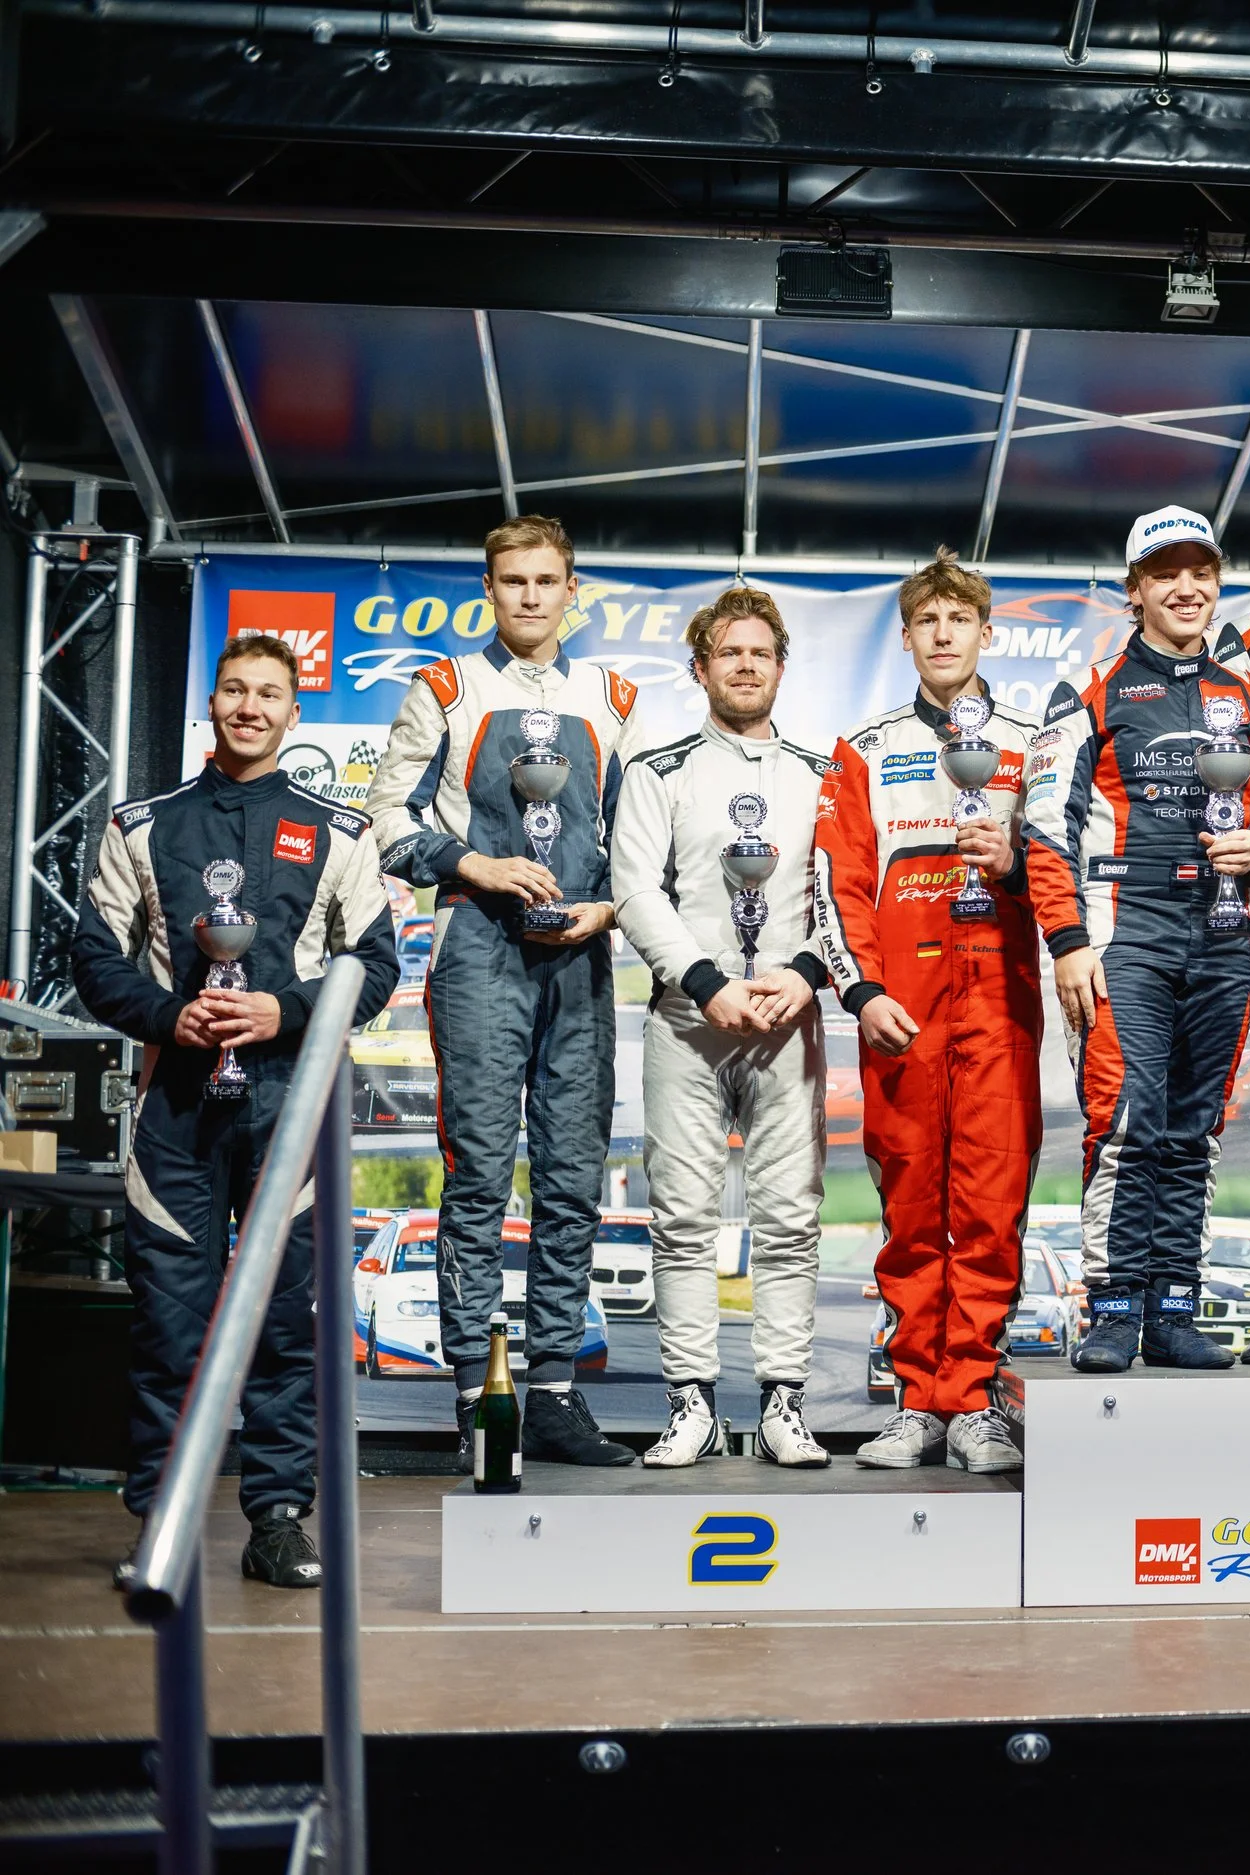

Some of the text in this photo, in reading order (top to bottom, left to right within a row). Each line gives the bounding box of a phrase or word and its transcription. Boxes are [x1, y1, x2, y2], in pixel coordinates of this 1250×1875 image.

[1143, 518, 1208, 537] GOODYEAR
[979, 626, 1082, 658] DMV
[1174, 663, 1198, 677] freem
[1119, 683, 1165, 694] HAMPL
[960, 706, 979, 714] DMV
[1212, 707, 1233, 715] DMV
[530, 719, 550, 728] DMV
[858, 733, 879, 749] OMP
[654, 756, 678, 770] OMP
[1133, 751, 1167, 767] JMS
[885, 771, 931, 783] RAVENOL
[995, 765, 1022, 778] MV
[738, 804, 758, 812] DMV
[123, 808, 151, 823] OMP
[333, 814, 360, 829] OMP
[896, 819, 930, 831] BMW
[279, 834, 312, 853] DMV
[276, 850, 312, 862] MOTORSPORT
[212, 870, 234, 880] DMV
[1098, 862, 1129, 876] freem
[392, 1083, 430, 1092] RAVENOL
[1094, 1300, 1130, 1312] sparco
[687, 1511, 780, 1587] 2
[1138, 1543, 1197, 1563] DMV
[1138, 1573, 1197, 1583] MOTORSPORT
